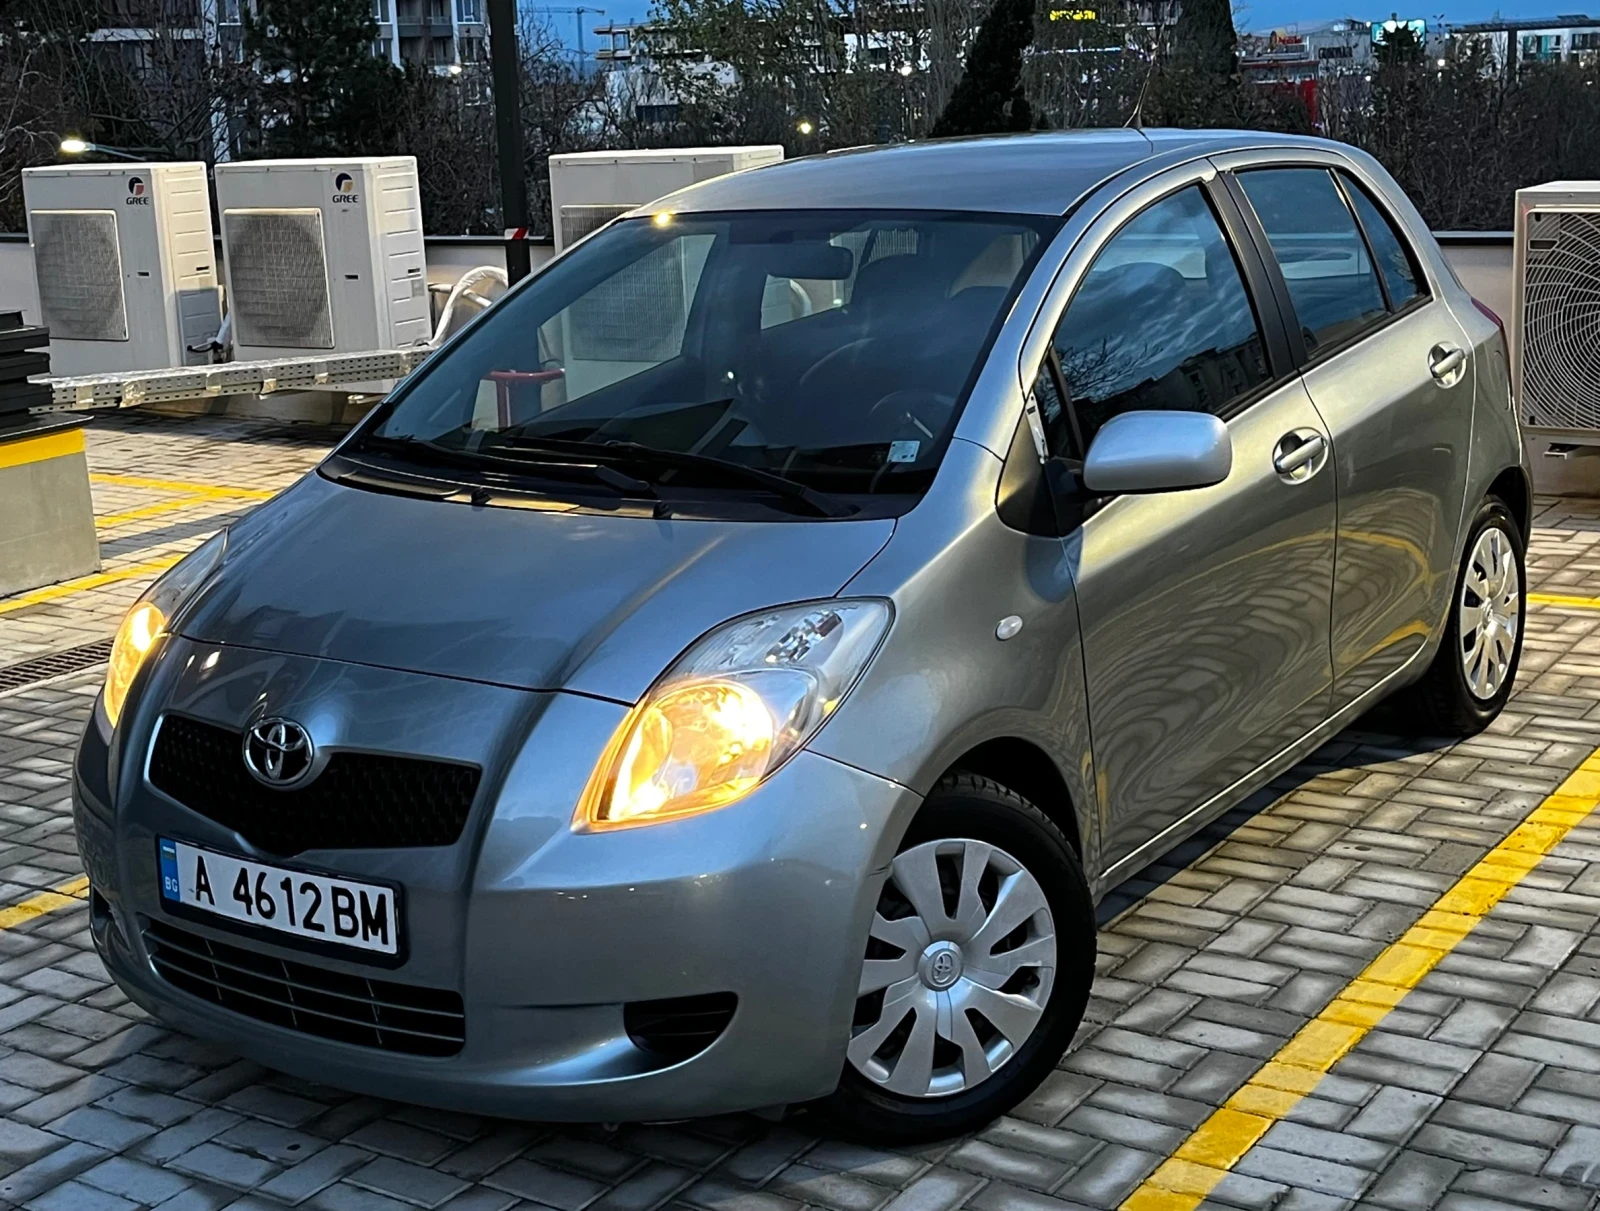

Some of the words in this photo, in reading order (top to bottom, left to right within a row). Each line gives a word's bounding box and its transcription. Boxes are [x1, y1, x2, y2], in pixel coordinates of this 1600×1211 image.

[126, 197, 149, 205] GREE
[332, 194, 359, 204] GREE
[164, 876, 178, 893] BG
[195, 855, 215, 906] A
